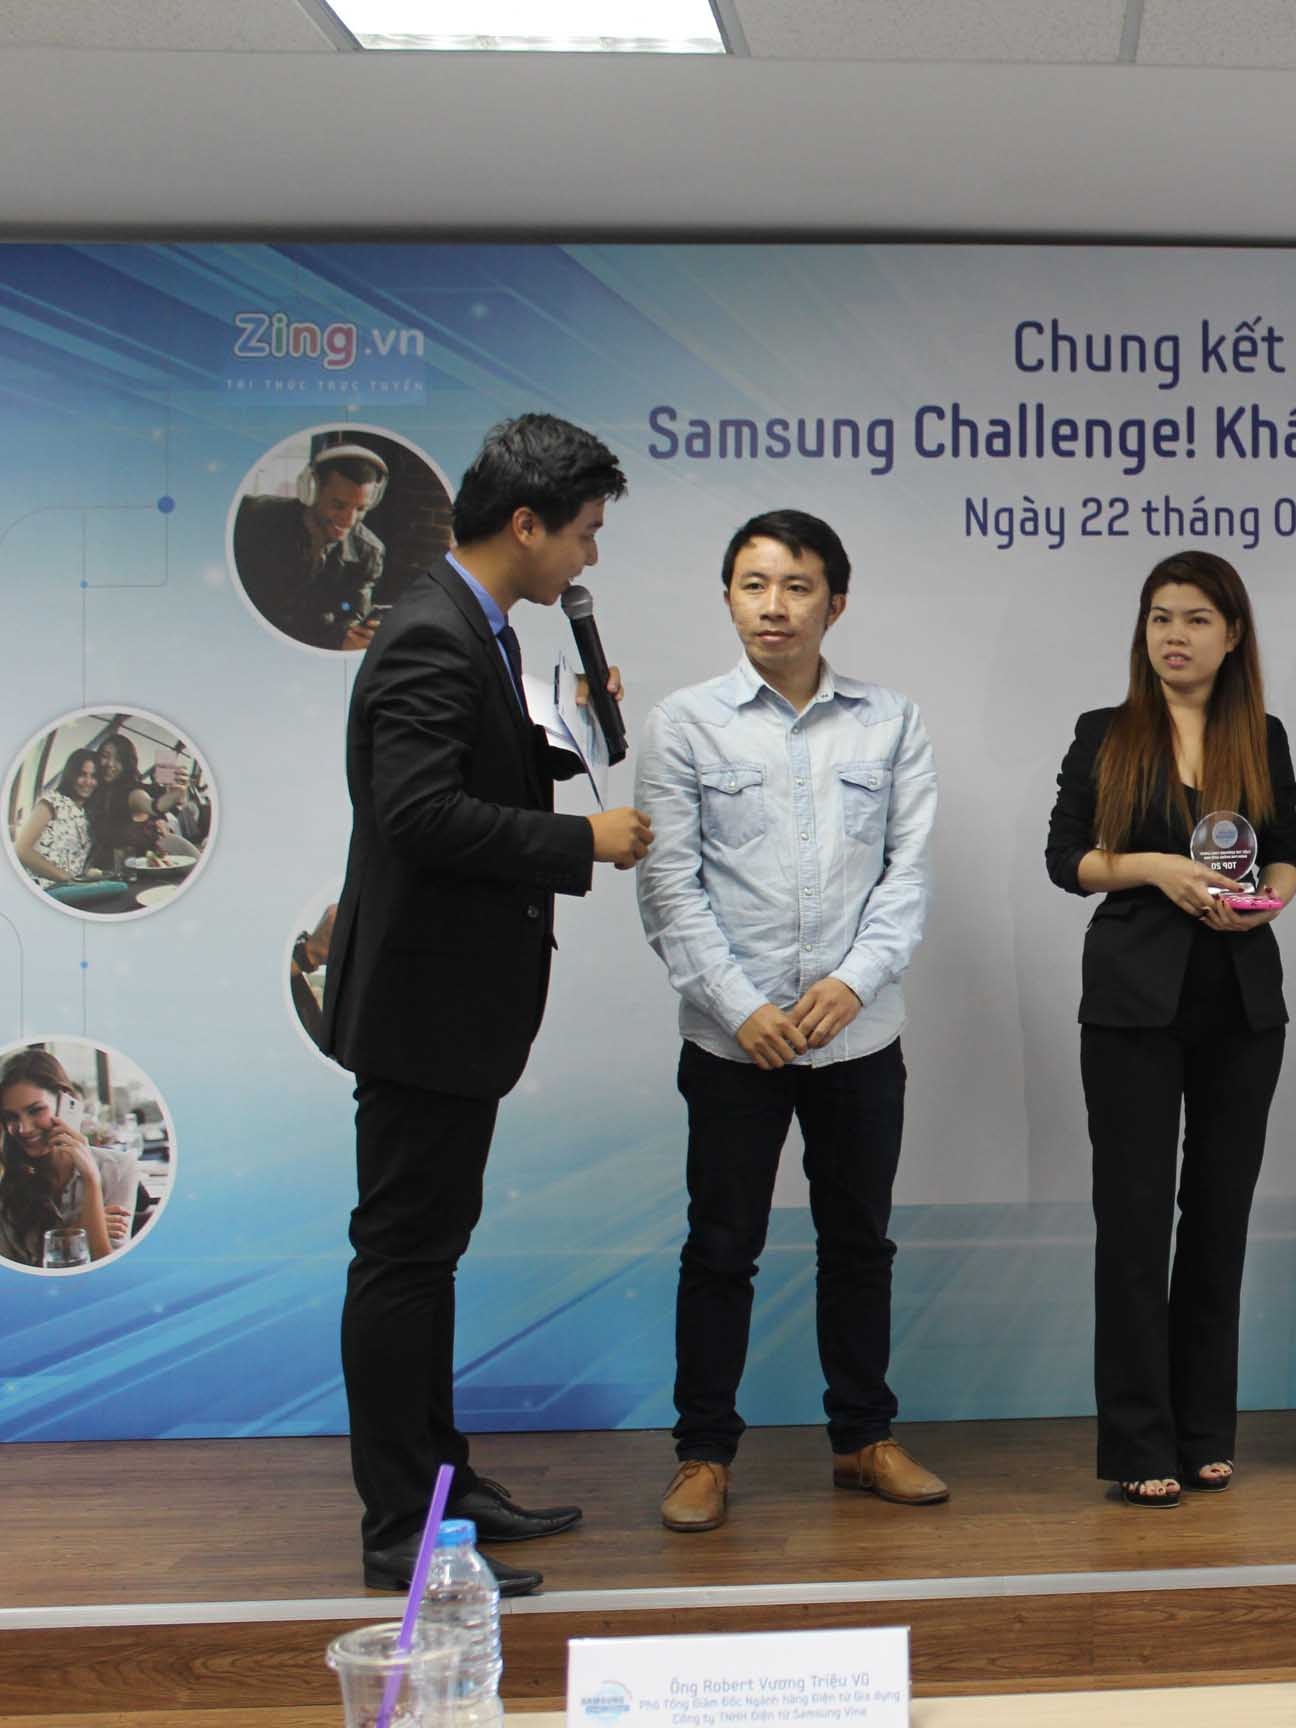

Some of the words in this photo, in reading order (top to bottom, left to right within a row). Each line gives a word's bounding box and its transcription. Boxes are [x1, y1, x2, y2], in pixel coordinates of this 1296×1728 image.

[233, 313, 425, 369] Zing.vn
[1014, 318, 1180, 390] Chung
[1201, 316, 1286, 374] kết
[648, 405, 895, 476] Samsung
[914, 402, 1195, 476] Challenge!
[965, 495, 1065, 550] Ngày
[1080, 498, 1130, 537] 22
[1142, 495, 1260, 550] tháng
[703, 1677, 753, 1693] Robert
